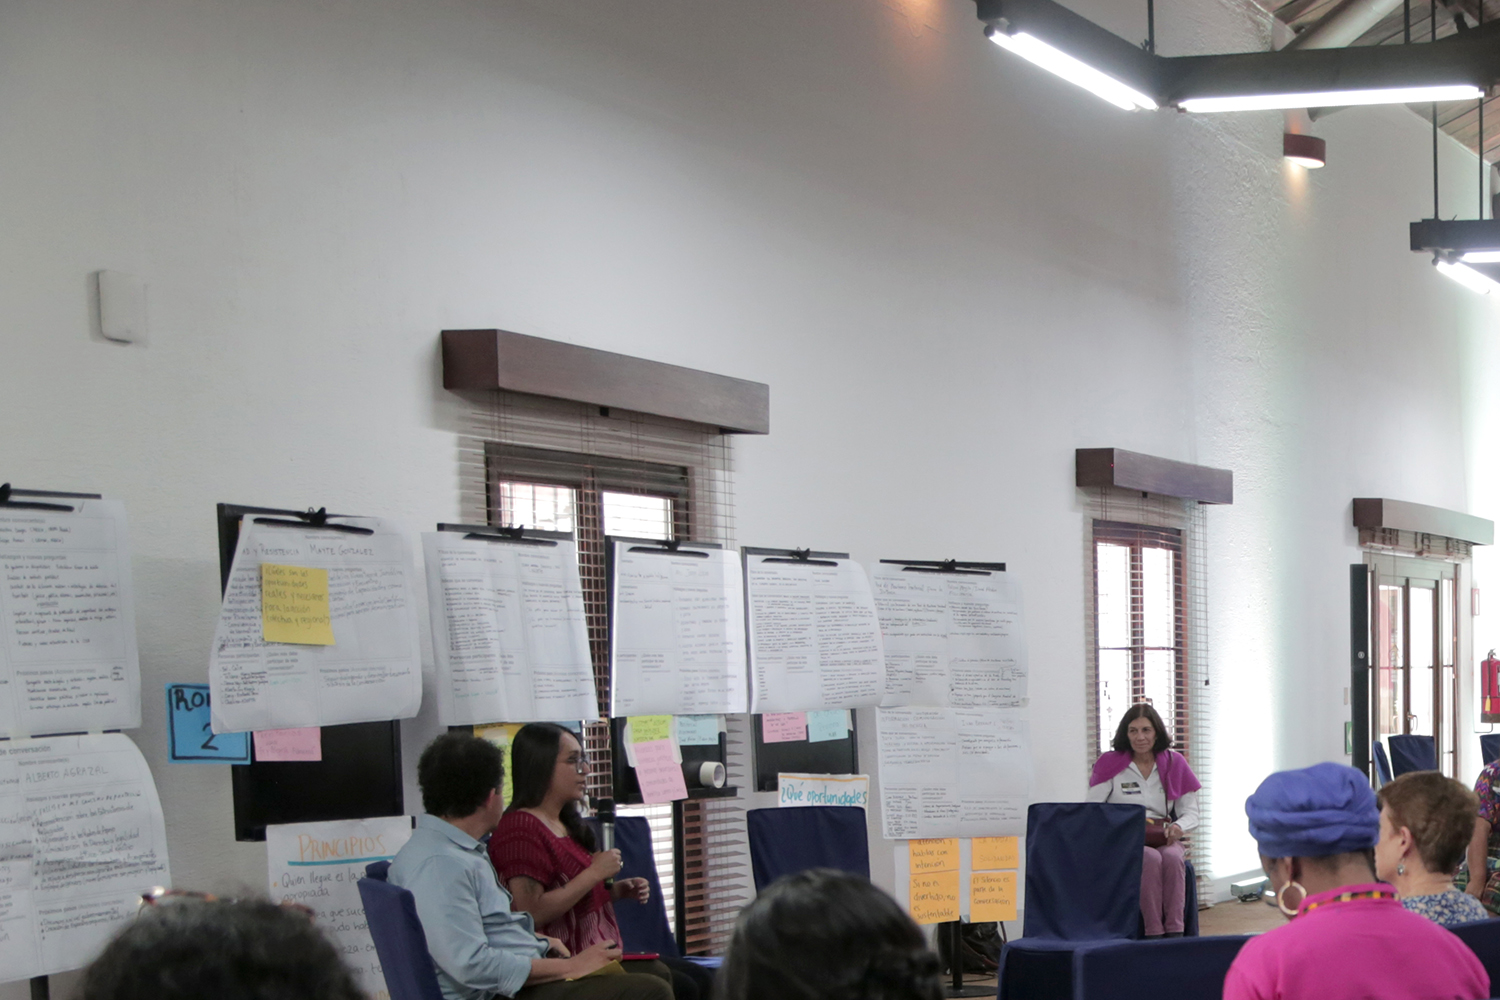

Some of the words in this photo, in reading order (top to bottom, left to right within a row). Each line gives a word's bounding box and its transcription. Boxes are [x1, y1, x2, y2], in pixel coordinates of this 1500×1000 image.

[264, 588, 287, 600] reales
[264, 603, 280, 614] para
[201, 722, 219, 751] 2
[9, 746, 51, 755] conversación
[26, 770, 60, 784] ALBERTO
[63, 766, 108, 779] AGRAZAL
[781, 780, 803, 804] ¿Qué
[807, 785, 868, 806] oportunidades
[298, 833, 386, 862] PRINCIPIOS
[916, 858, 946, 869] intención
[282, 872, 306, 889] Quien
[310, 869, 332, 890] llegue
[336, 873, 344, 883] es
[348, 867, 360, 884] la
[912, 879, 920, 888] Si
[973, 887, 987, 896] parte
[974, 896, 1010, 906] conversación
[330, 910, 345, 924] que
[917, 908, 954, 920] sustentable
